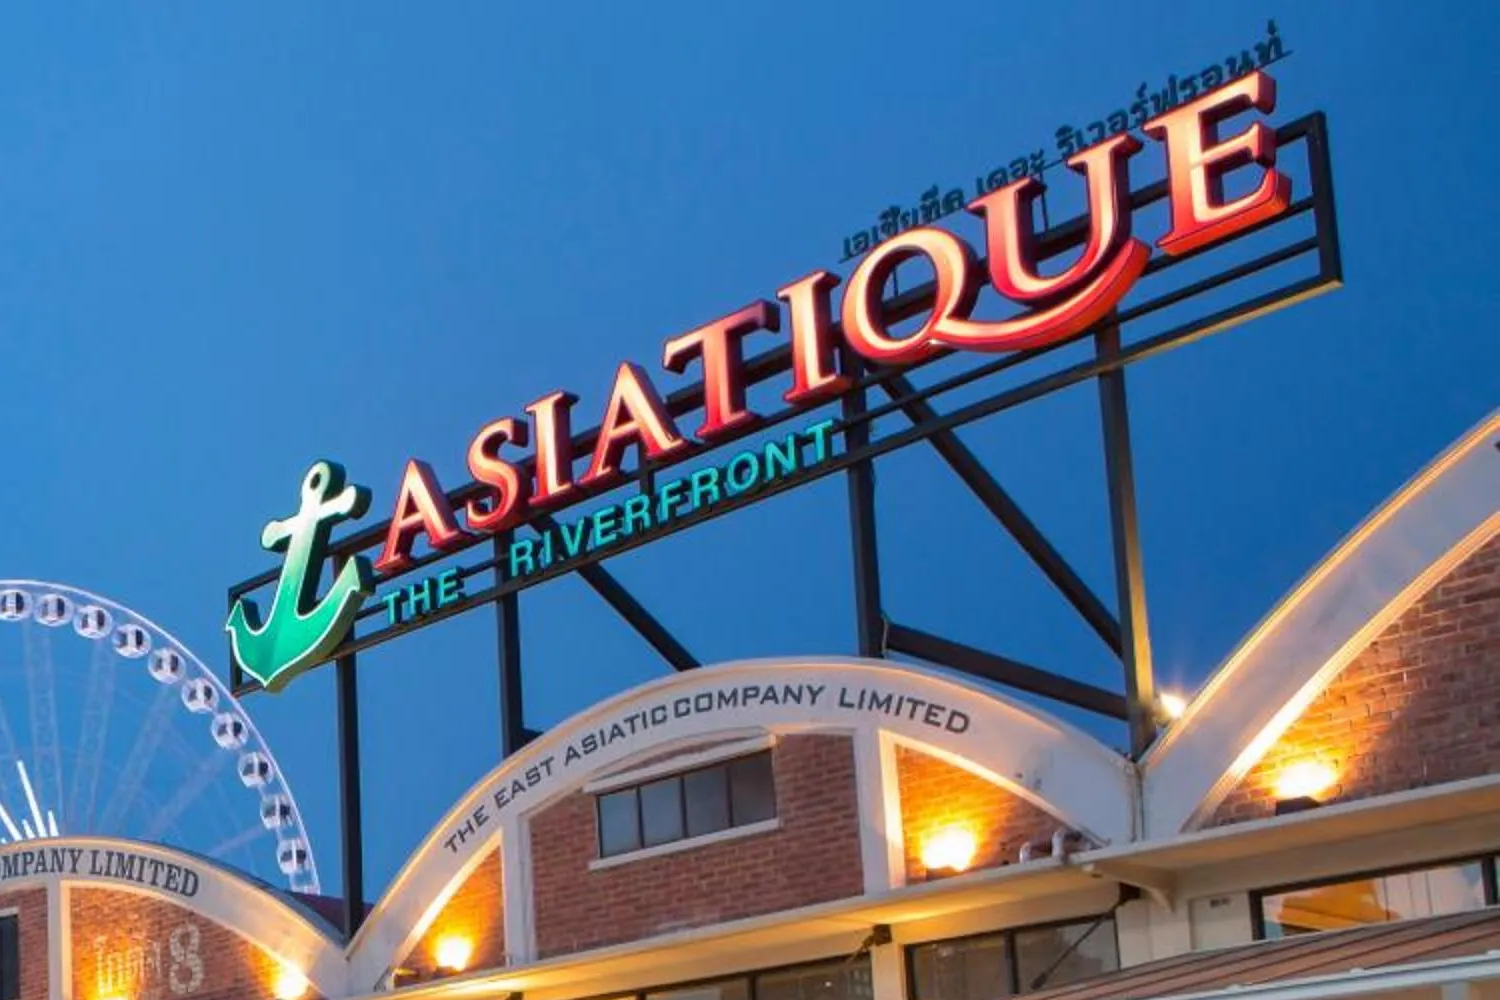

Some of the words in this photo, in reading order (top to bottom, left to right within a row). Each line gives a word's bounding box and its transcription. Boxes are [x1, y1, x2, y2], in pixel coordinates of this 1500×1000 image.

[374, 68, 1290, 573] ASIATIQUE
[382, 565, 465, 626] THE
[509, 417, 837, 578] RIVERFRONT
[444, 804, 490, 853] THE
[493, 756, 554, 811] EAST
[563, 704, 668, 767] ASIATIC
[673, 684, 826, 719] COMPANY
[838, 687, 971, 735] LIMITED
[88, 849, 200, 898] LIMITED
[169, 922, 202, 995] 8
